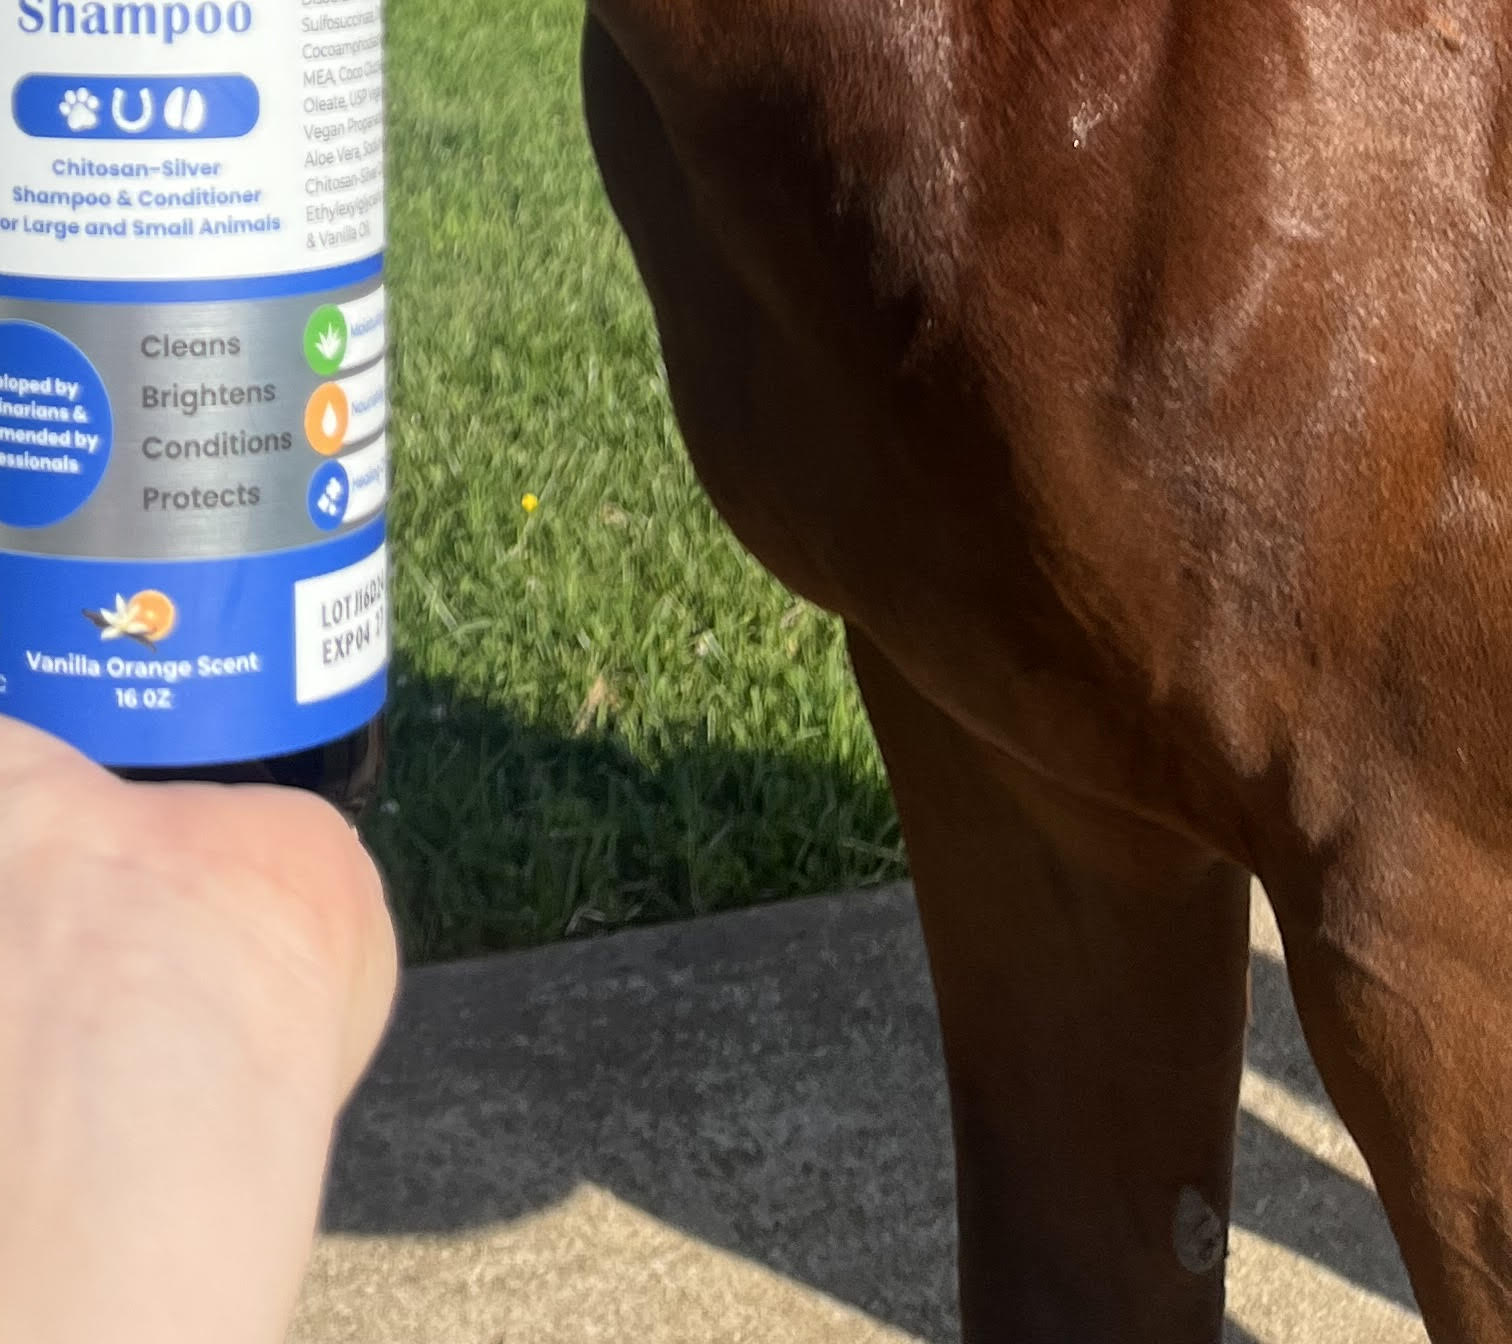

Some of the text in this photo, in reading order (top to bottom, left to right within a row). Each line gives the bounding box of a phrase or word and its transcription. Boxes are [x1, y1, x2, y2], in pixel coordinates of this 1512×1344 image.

[303, 121, 345, 142] Vegan
[304, 150, 335, 168] Aloe
[12, 185, 263, 211] Shampoo & Conditioner
[23, 214, 80, 240] Large
[84, 217, 127, 237] and
[132, 216, 194, 237] Small
[199, 214, 282, 236] Animals
[140, 333, 241, 358] Cleans
[55, 377, 80, 402] by
[141, 382, 277, 416] Brightens
[73, 405, 88, 424] &
[74, 429, 100, 454] by
[141, 429, 293, 460] Conditions
[142, 483, 262, 511] Protects
[26, 650, 261, 683] Vanilla Orange Scent
[115, 687, 138, 709] 16
